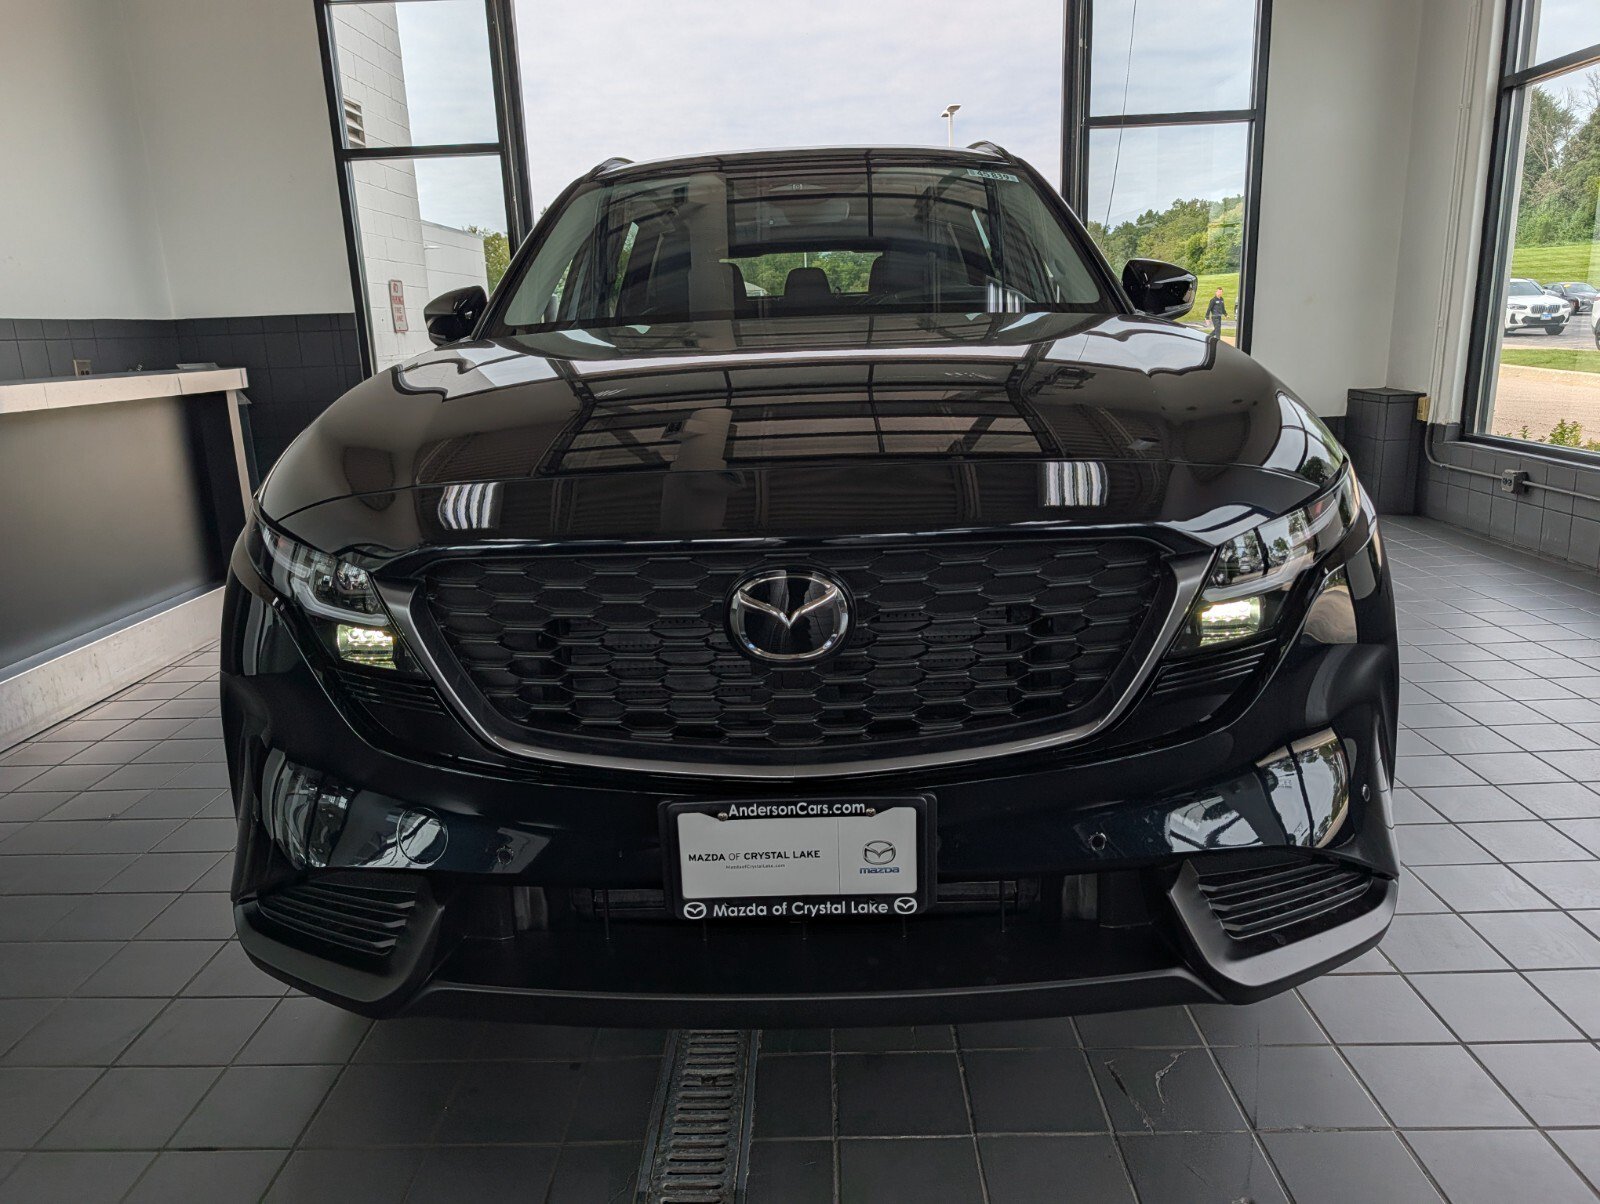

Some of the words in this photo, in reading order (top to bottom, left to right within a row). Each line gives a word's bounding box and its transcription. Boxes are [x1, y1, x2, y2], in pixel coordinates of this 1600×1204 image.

[977, 170, 1010, 180] 45839
[728, 802, 866, 817] AndersonCars.com
[688, 853, 726, 862] MAZDA
[728, 852, 740, 861] OF
[743, 851, 790, 861] CRYSTAL
[793, 850, 821, 859] LAKE
[713, 903, 767, 917] Mazda
[772, 902, 787, 915] of
[791, 901, 846, 917] Crystal
[851, 900, 889, 914] Lake
